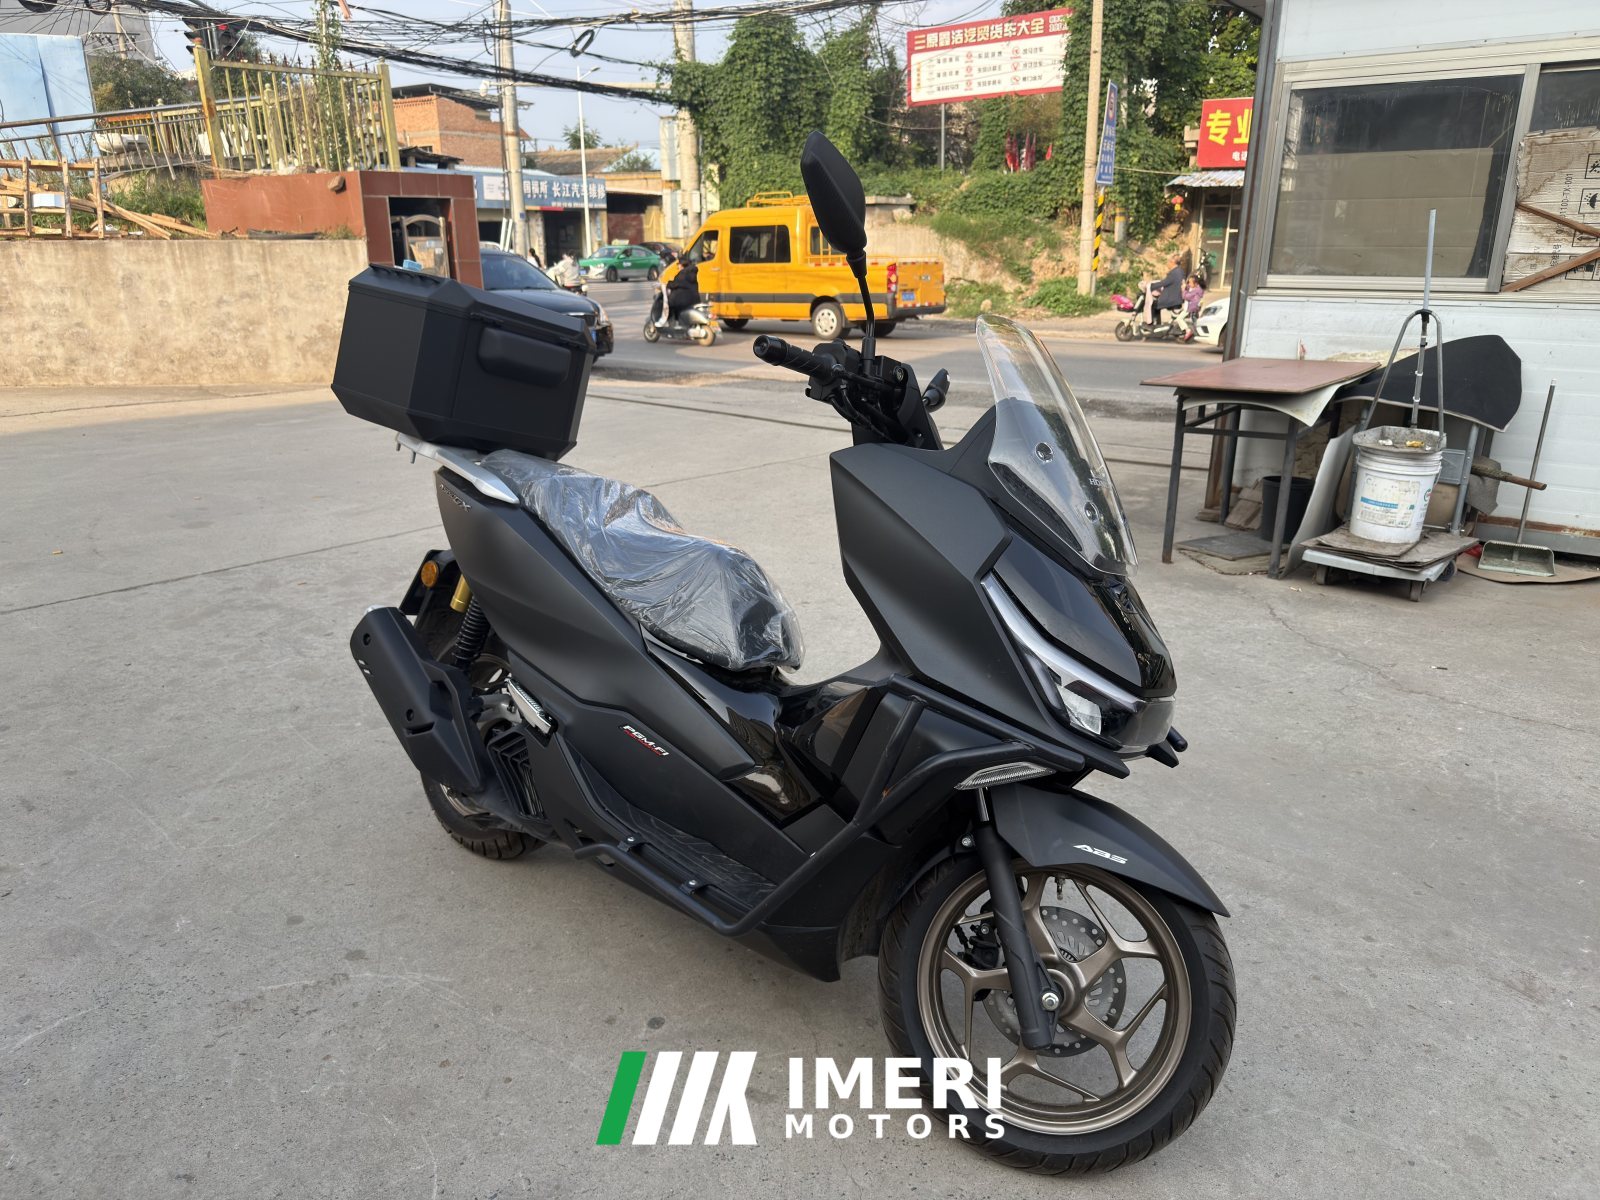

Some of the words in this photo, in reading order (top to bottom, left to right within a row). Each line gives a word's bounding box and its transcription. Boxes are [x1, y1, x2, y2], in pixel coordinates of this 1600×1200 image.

[1206, 108, 1253, 146] 专业
[623, 725, 669, 756] PGM-FI
[1073, 844, 1128, 864] ABS
